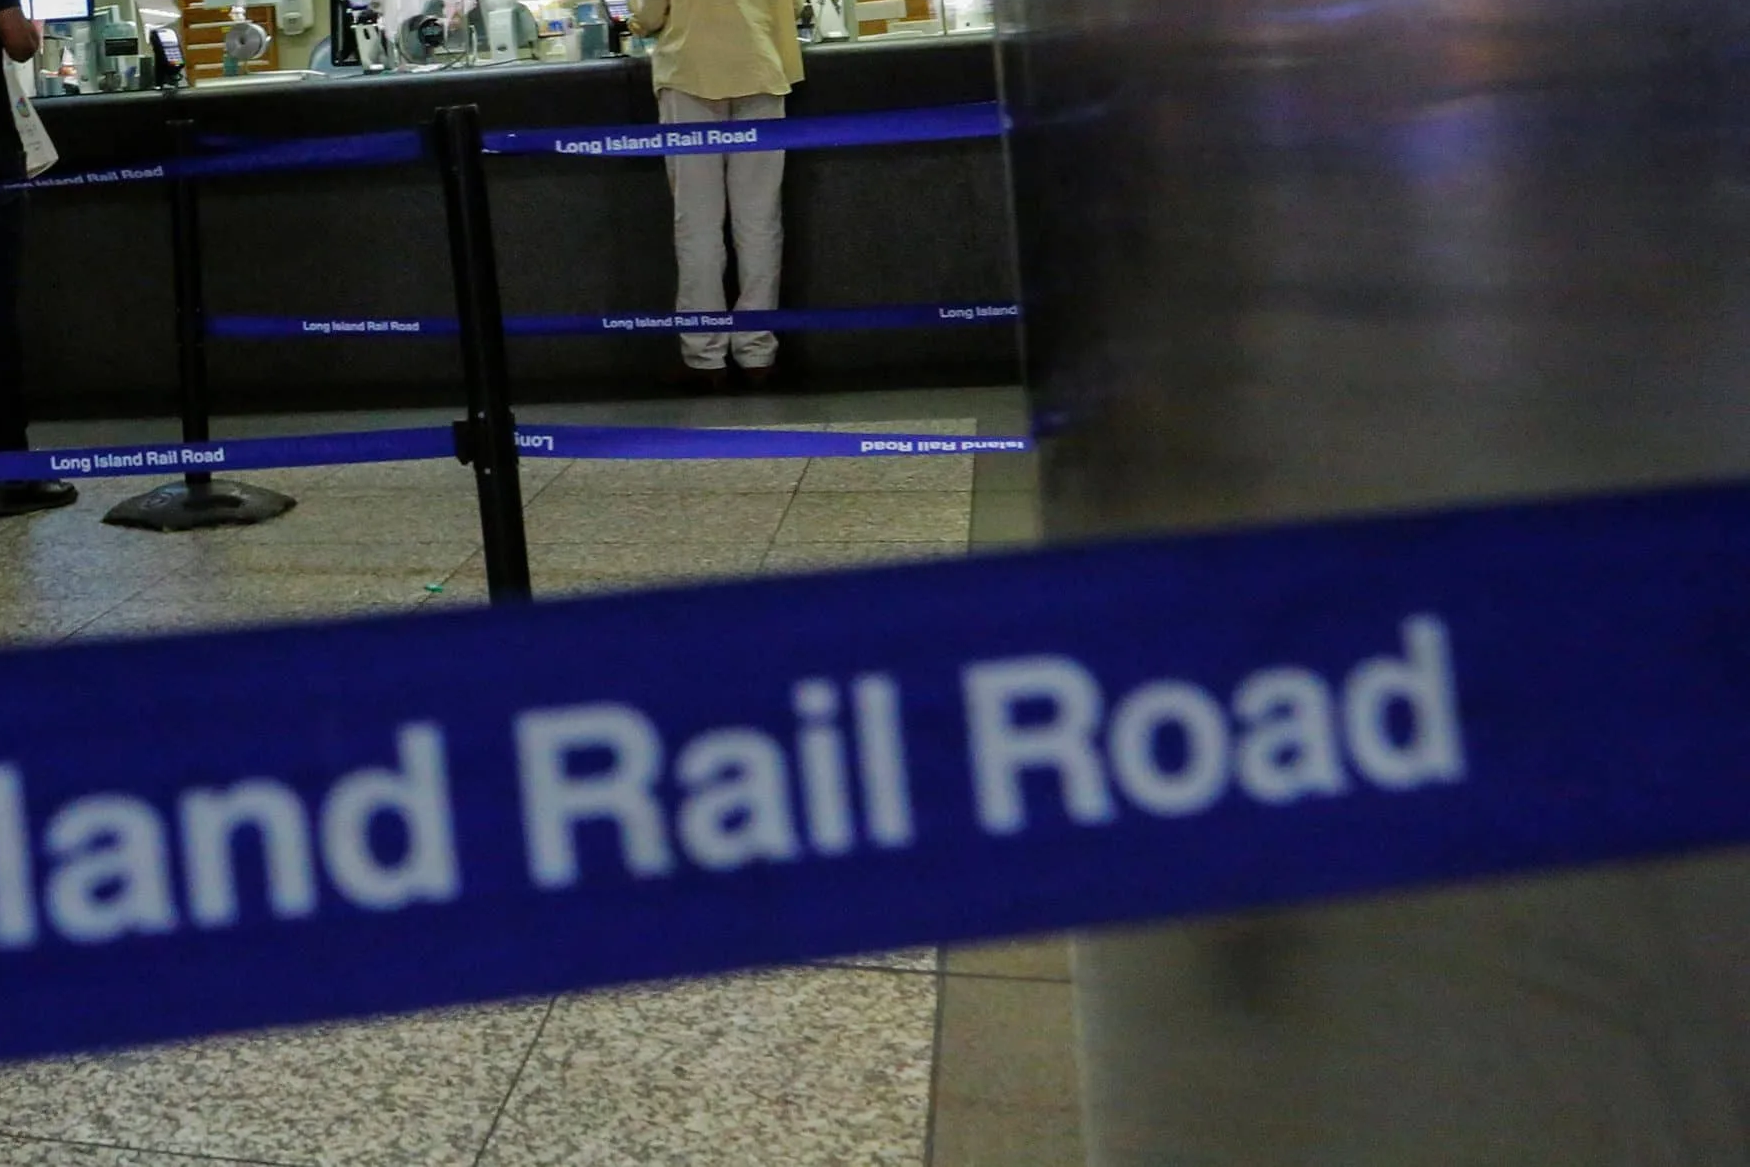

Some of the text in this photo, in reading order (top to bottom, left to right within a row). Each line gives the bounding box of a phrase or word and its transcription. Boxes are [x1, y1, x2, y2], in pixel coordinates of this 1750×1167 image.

[555, 128, 757, 155] Long Island Rail Road
[602, 315, 733, 330] Long Island Rail Road
[51, 448, 225, 473] Long Island Rail Road
[517, 676, 911, 886] Rail
[964, 618, 1463, 832] Road
